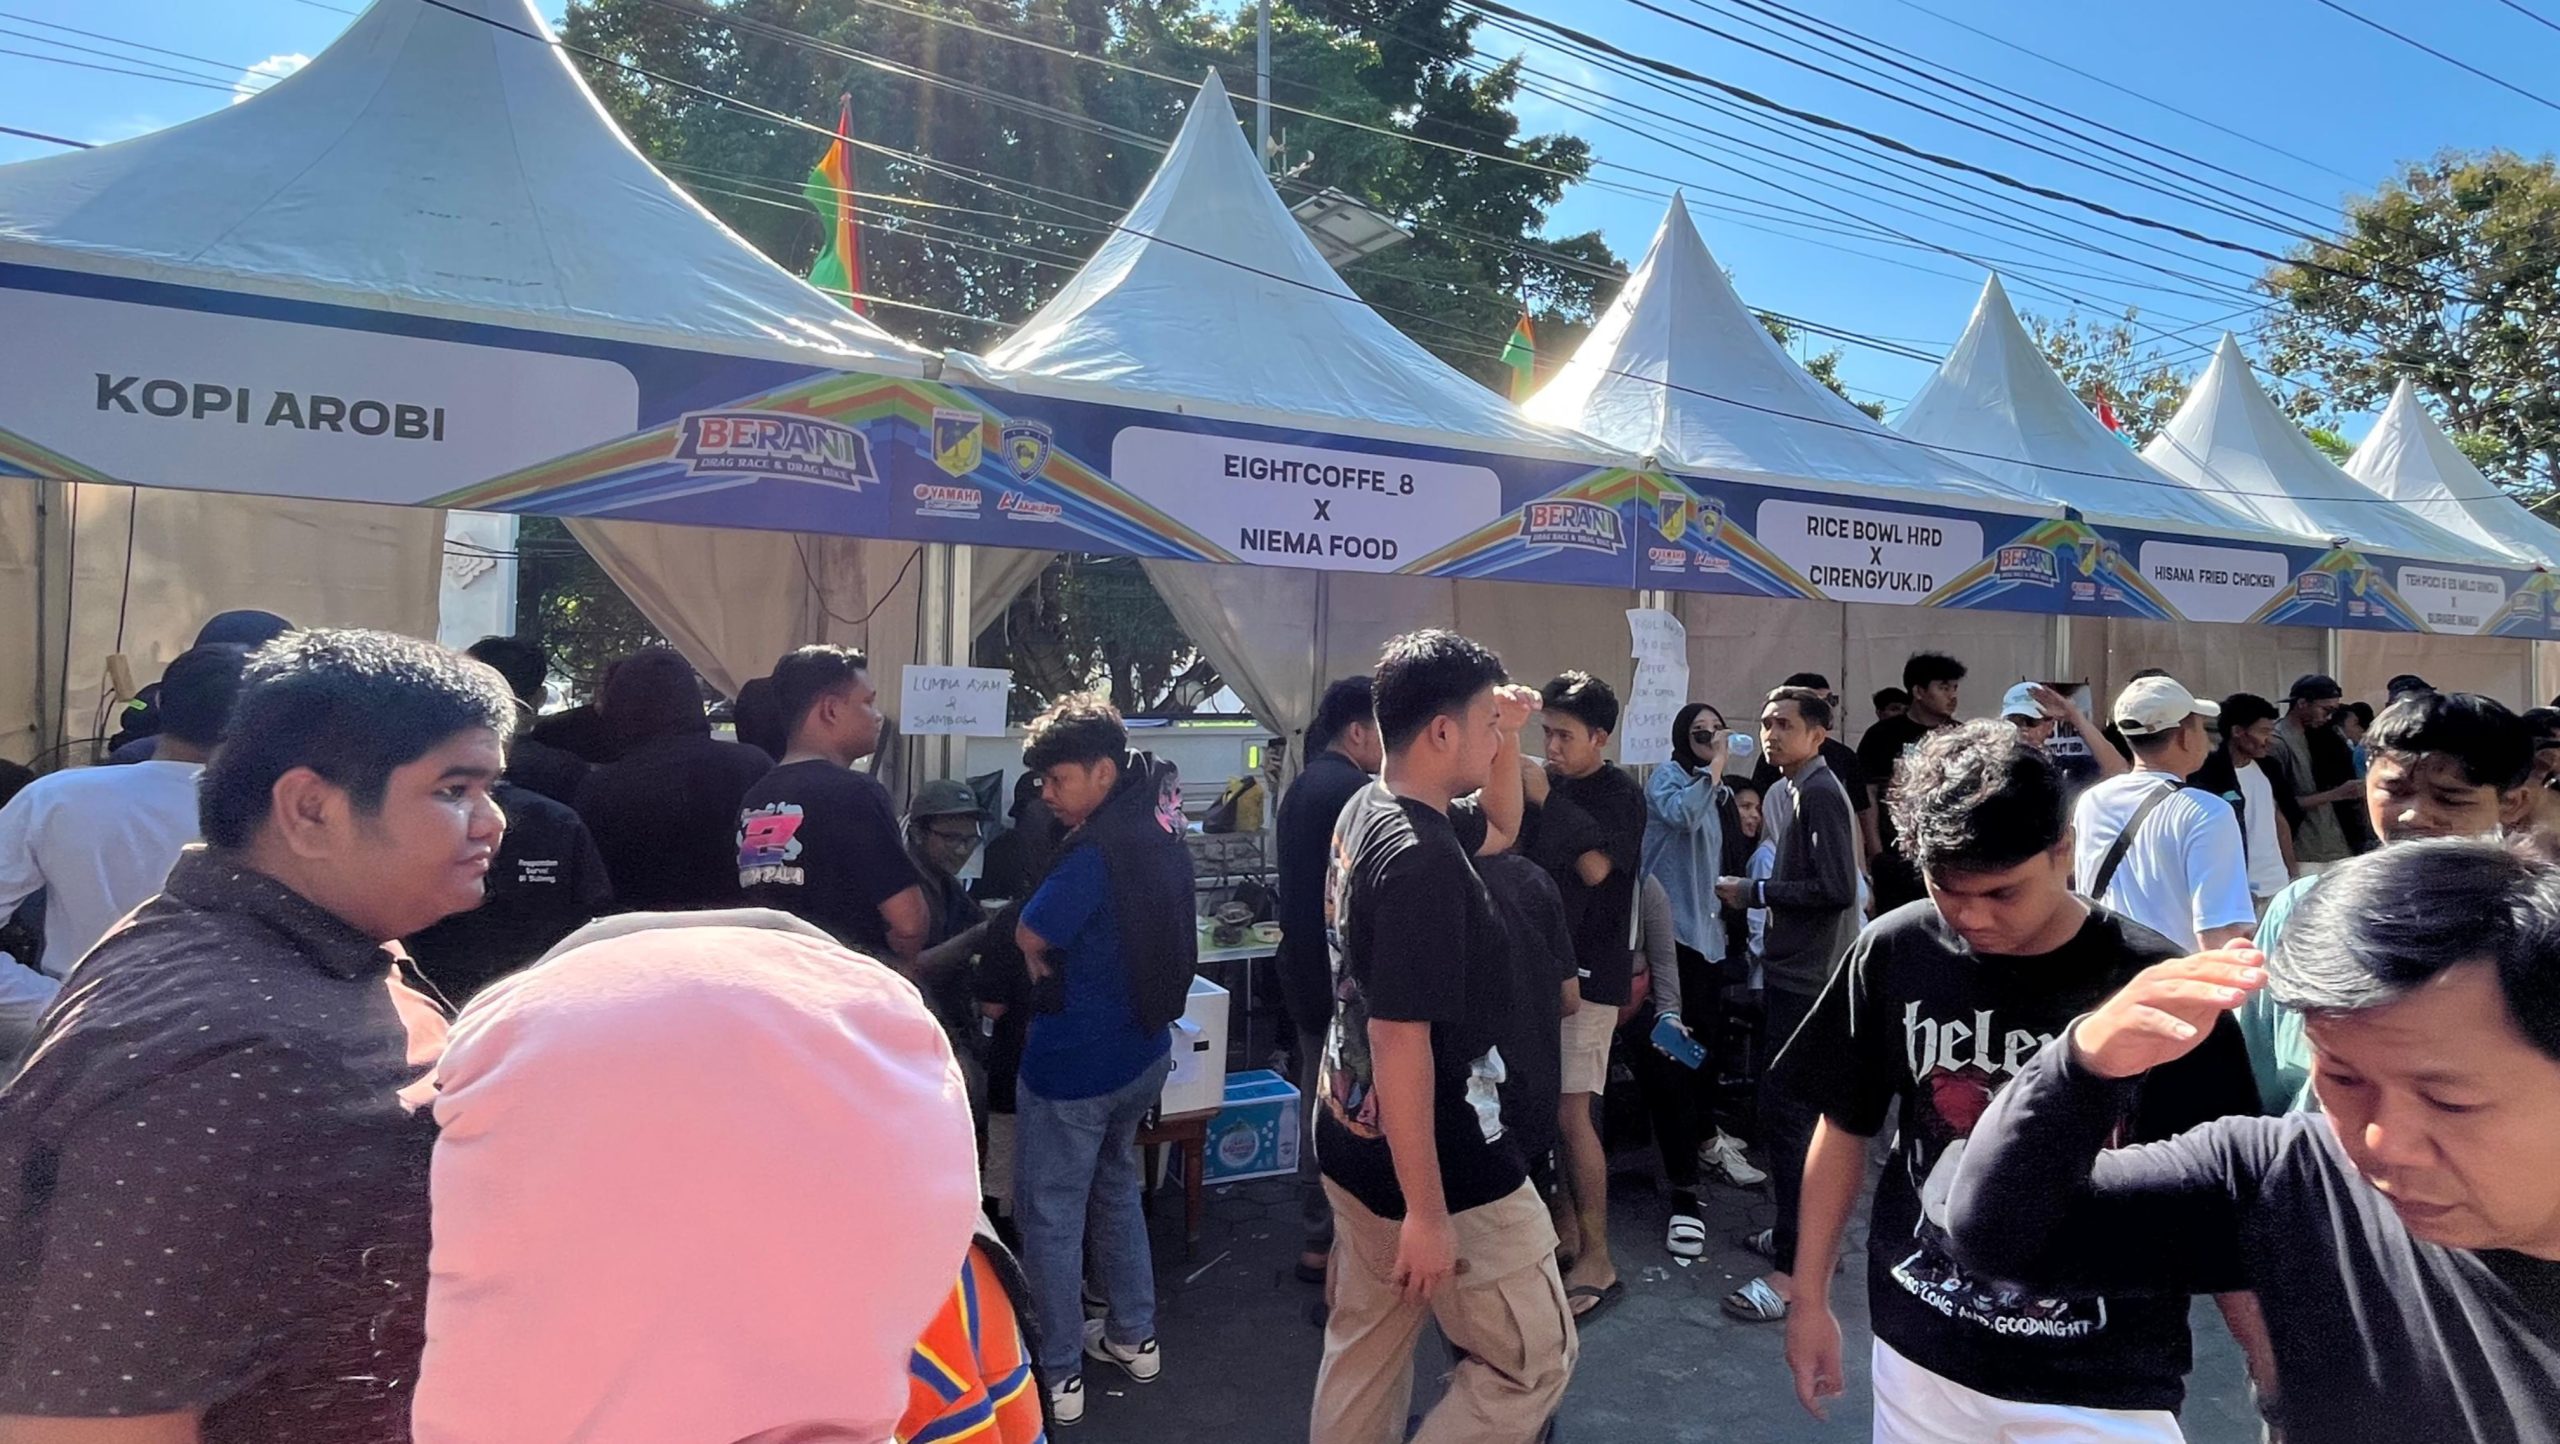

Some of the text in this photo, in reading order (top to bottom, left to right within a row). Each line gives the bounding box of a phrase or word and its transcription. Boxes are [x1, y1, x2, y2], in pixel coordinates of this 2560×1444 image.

[95, 372, 445, 441] KOPI AROBI
[696, 417, 856, 470] BERANI
[701, 458, 734, 468] DRAG
[738, 459, 769, 469] RACE
[774, 461, 783, 470] &
[787, 462, 819, 475] DRAG
[1224, 454, 1415, 496] EIGHTCOFFE_8
[930, 486, 982, 503] YAMAHA
[1313, 499, 1331, 521] X
[1531, 505, 1614, 539] BERANI
[1807, 516, 1942, 547] RICE BOWL HRD
[1240, 528, 1398, 560] NIEMA FOOD
[1870, 546, 1882, 565] X
[1810, 565, 1933, 592] CIRENGYUK.ID
[2154, 566, 2275, 588] HISANA FRIED CHICKEN
[1920, 1286, 1953, 1317] LONG
[1995, 1317, 2092, 1337] GOODNIGHT
